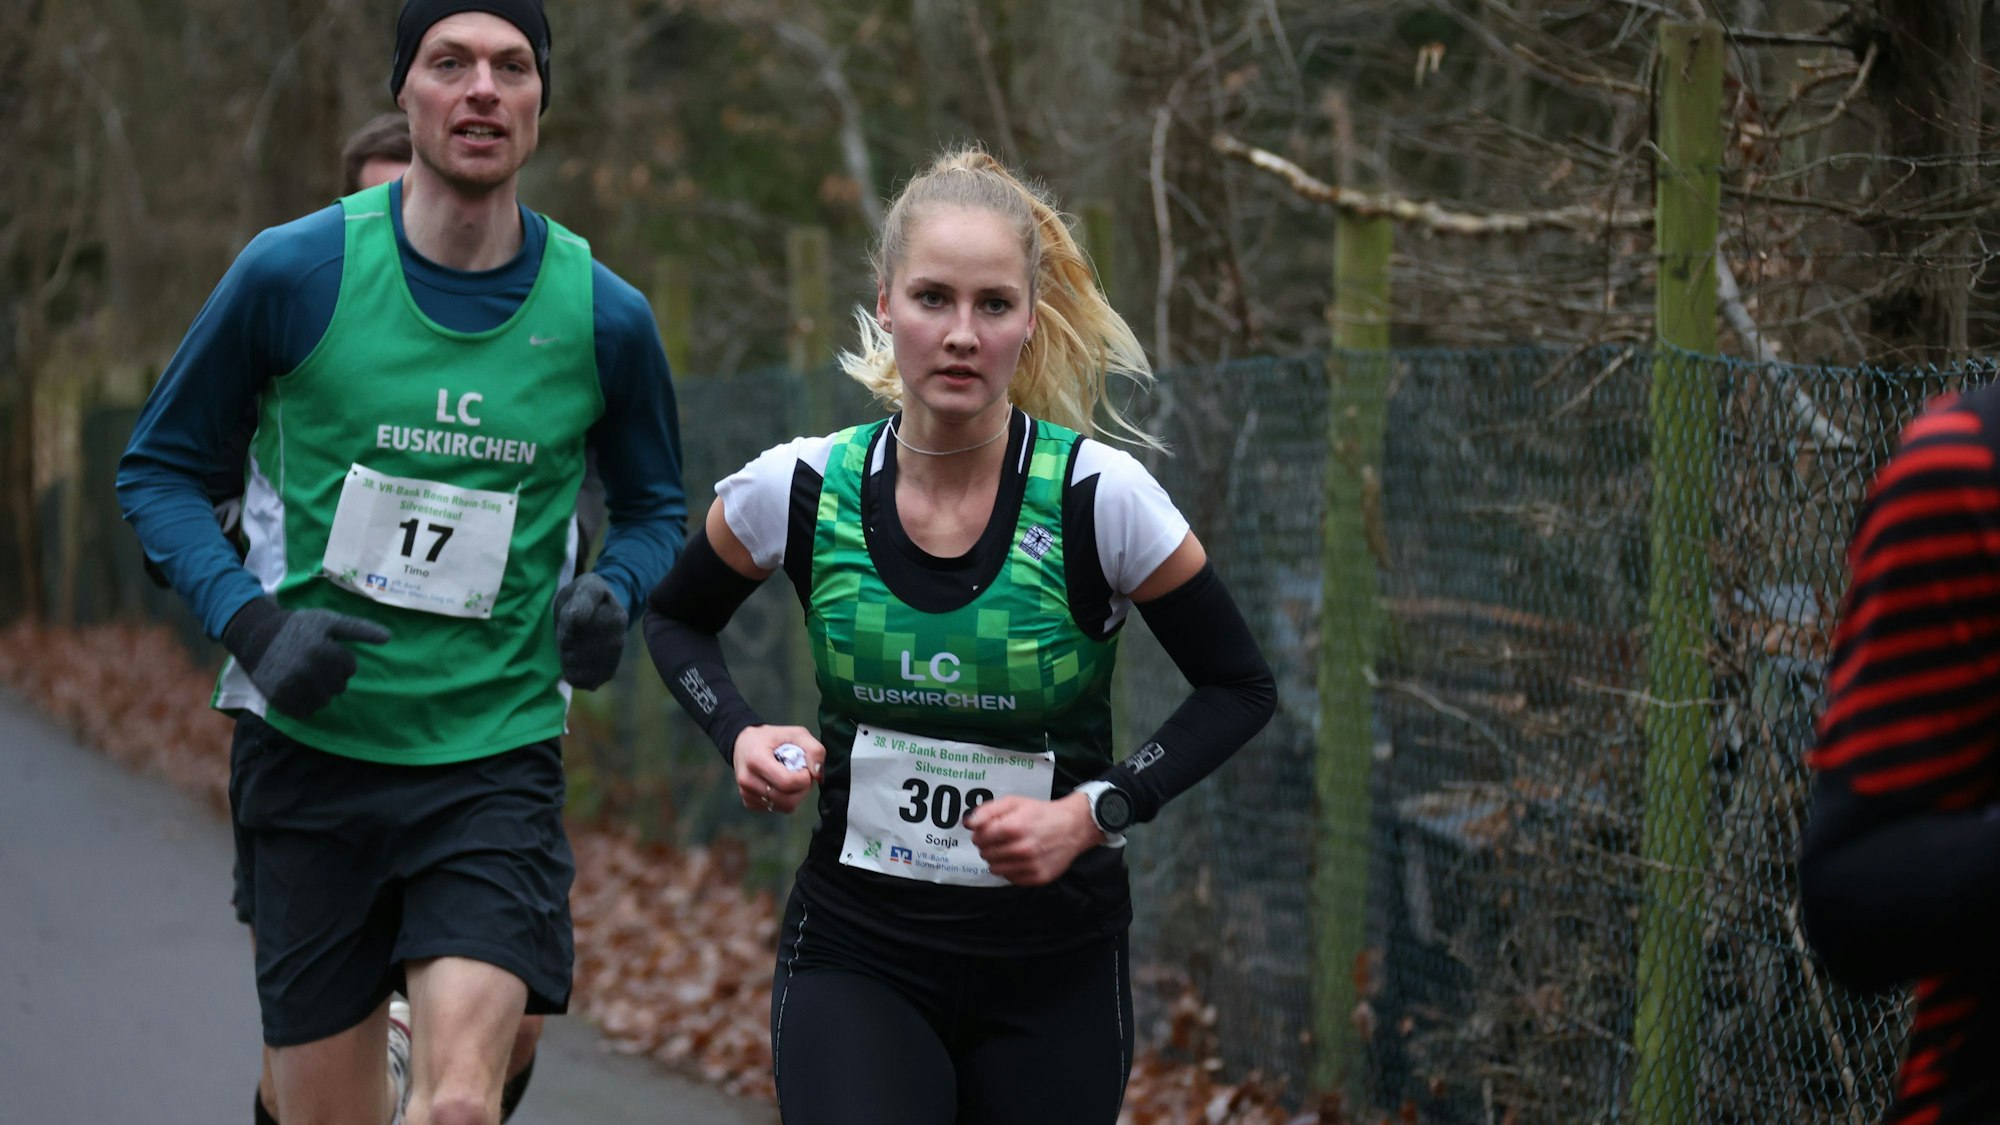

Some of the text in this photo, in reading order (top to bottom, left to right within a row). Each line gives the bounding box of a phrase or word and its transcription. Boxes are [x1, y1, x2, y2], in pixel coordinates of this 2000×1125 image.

[436, 388, 483, 426] LC
[376, 424, 537, 464] EUSKIRCHEN
[379, 482, 420, 498] VR-Bank
[423, 489, 449, 504] Bonn
[452, 495, 502, 513] Rhein-Sieg
[400, 500, 463, 520] Silvesterlauf
[399, 518, 454, 563] 17
[404, 564, 429, 578] Timo
[901, 650, 960, 683] LC
[853, 685, 1016, 710] EUSKIRCHEN
[873, 736, 1034, 769] 38. VR-Bank Bonn Rhein-Sieg
[915, 760, 986, 780] Silvesterlauf
[899, 778, 994, 831] 308
[916, 851, 950, 863] VR-Bank
[925, 834, 958, 849] Sonja
